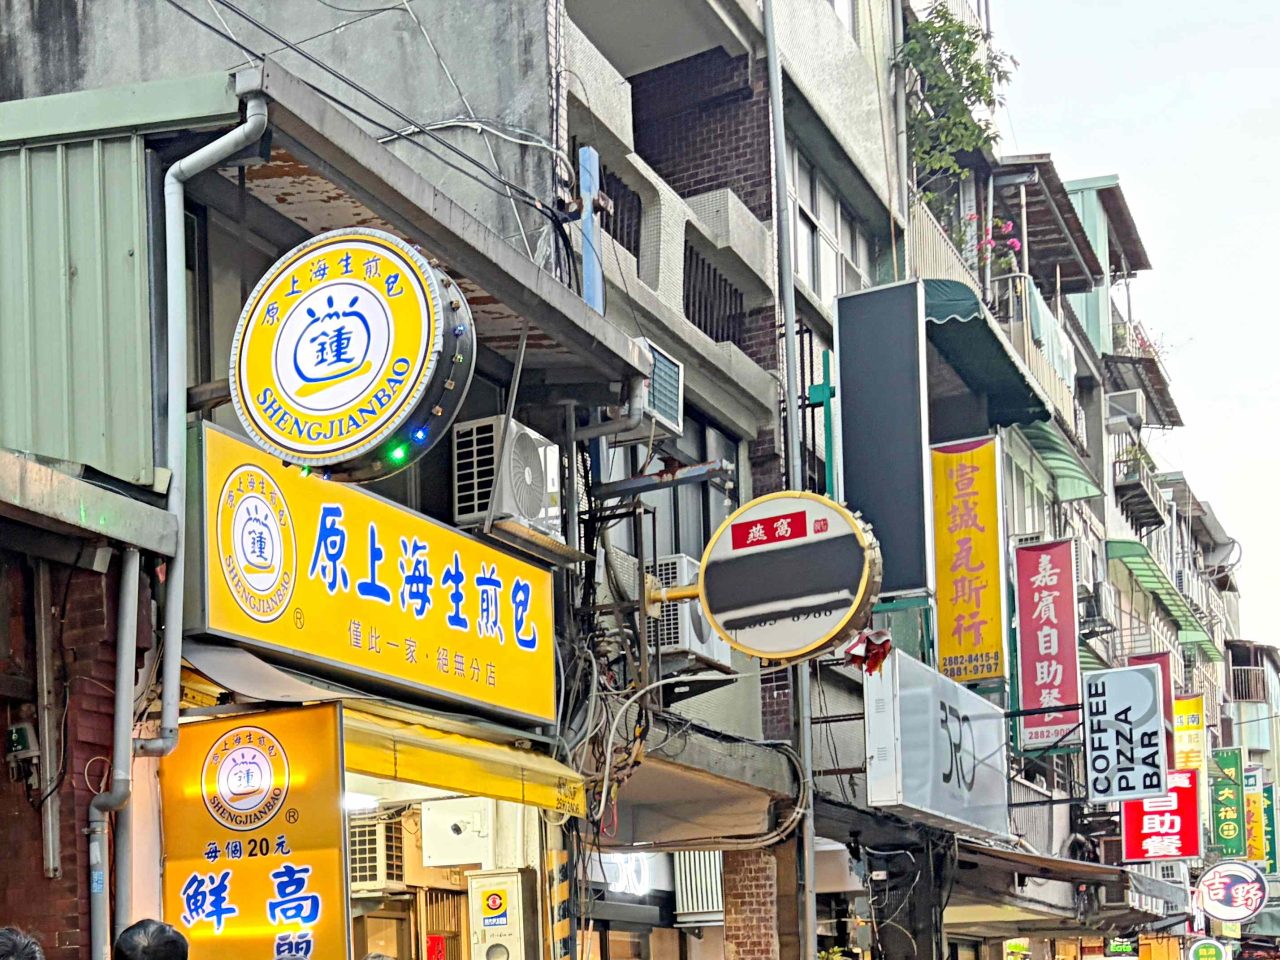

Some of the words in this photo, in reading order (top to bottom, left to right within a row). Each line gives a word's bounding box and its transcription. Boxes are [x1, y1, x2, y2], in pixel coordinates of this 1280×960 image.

[261, 251, 404, 327] 原上海生煎包
[256, 357, 412, 442] SHENGJIANBAO
[745, 517, 793, 545] 燕窩
[947, 462, 988, 648] 宣誠瓦斯行
[225, 554, 291, 614] SHENGJIANBAO
[309, 505, 538, 650] 原上海生煎包
[1029, 553, 1066, 723] 嘉賓自助餐
[1087, 680, 1112, 795] COFFEE
[1113, 705, 1137, 793] PIZZA
[1140, 729, 1162, 791] BAR
[209, 787, 282, 826] SHENGJIANBAO
